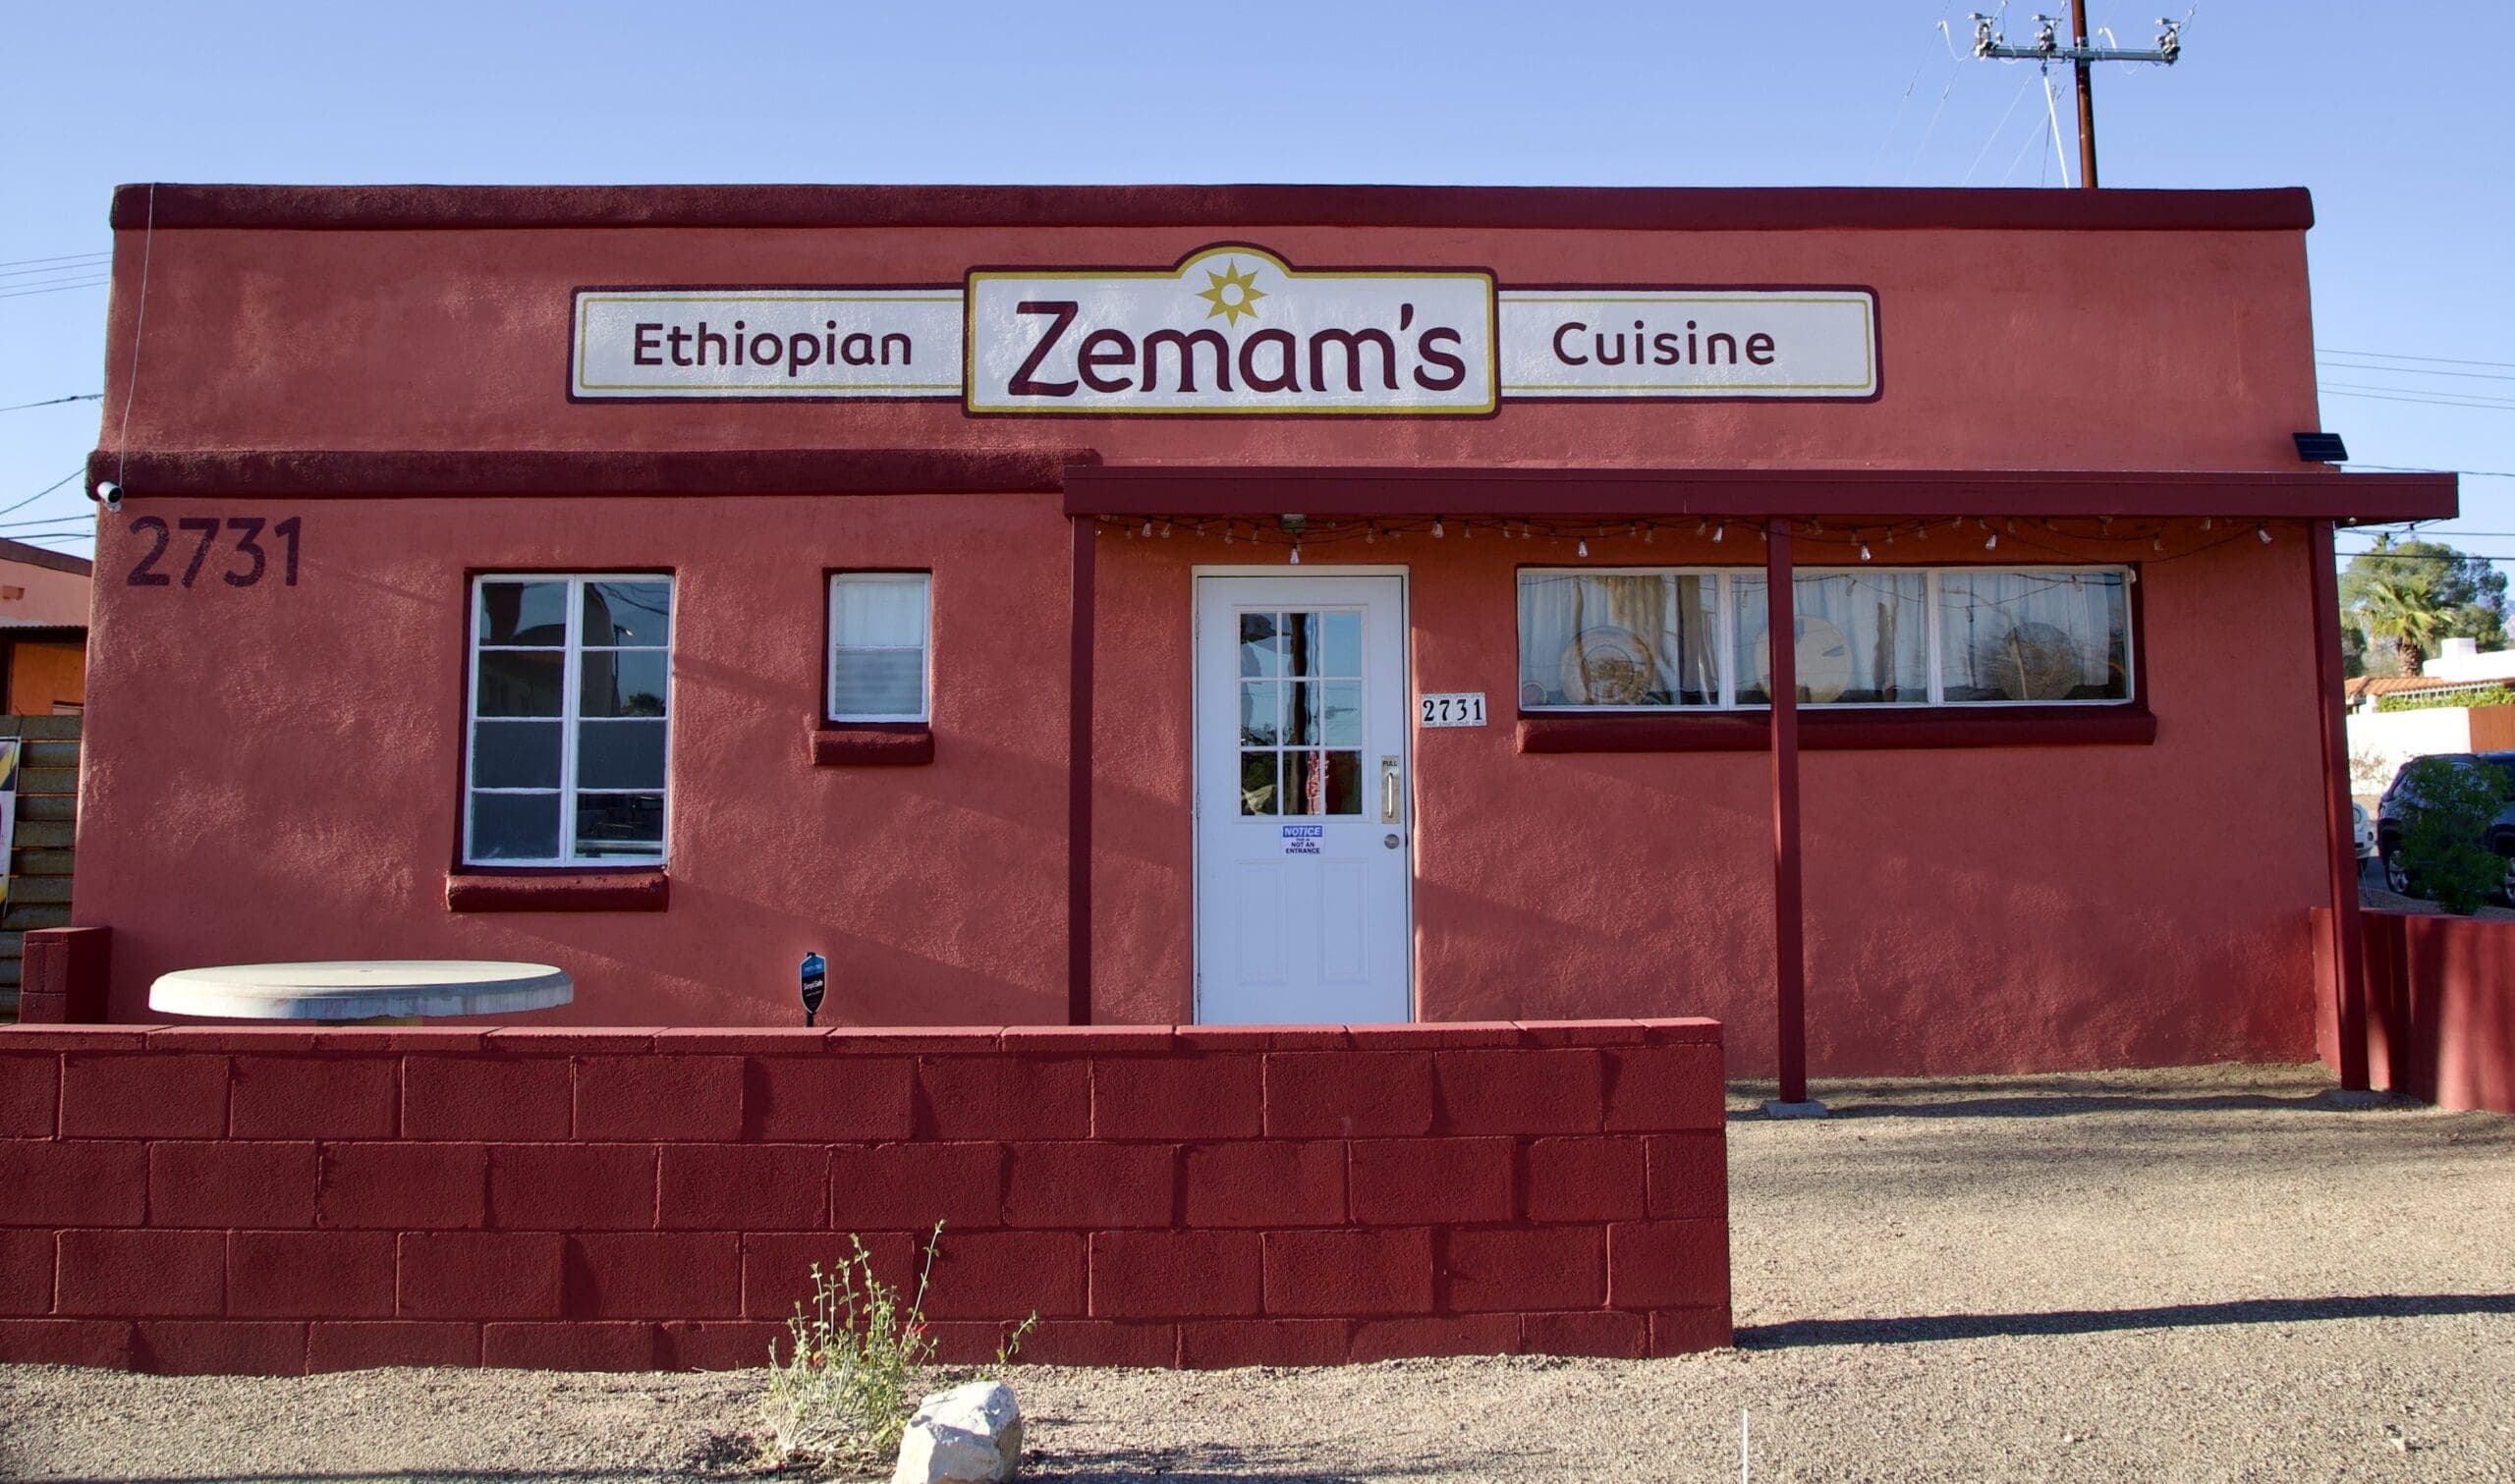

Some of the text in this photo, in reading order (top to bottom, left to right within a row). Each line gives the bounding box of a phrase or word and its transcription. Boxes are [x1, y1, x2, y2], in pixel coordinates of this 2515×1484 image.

[635, 320, 911, 377] Ethiopian
[1008, 302, 1465, 396] Zemam's
[1553, 320, 1774, 366] Cuisine
[127, 517, 301, 587] 2731
[1423, 698, 1482, 722] 2731
[1285, 827, 1321, 836] NOTICE
